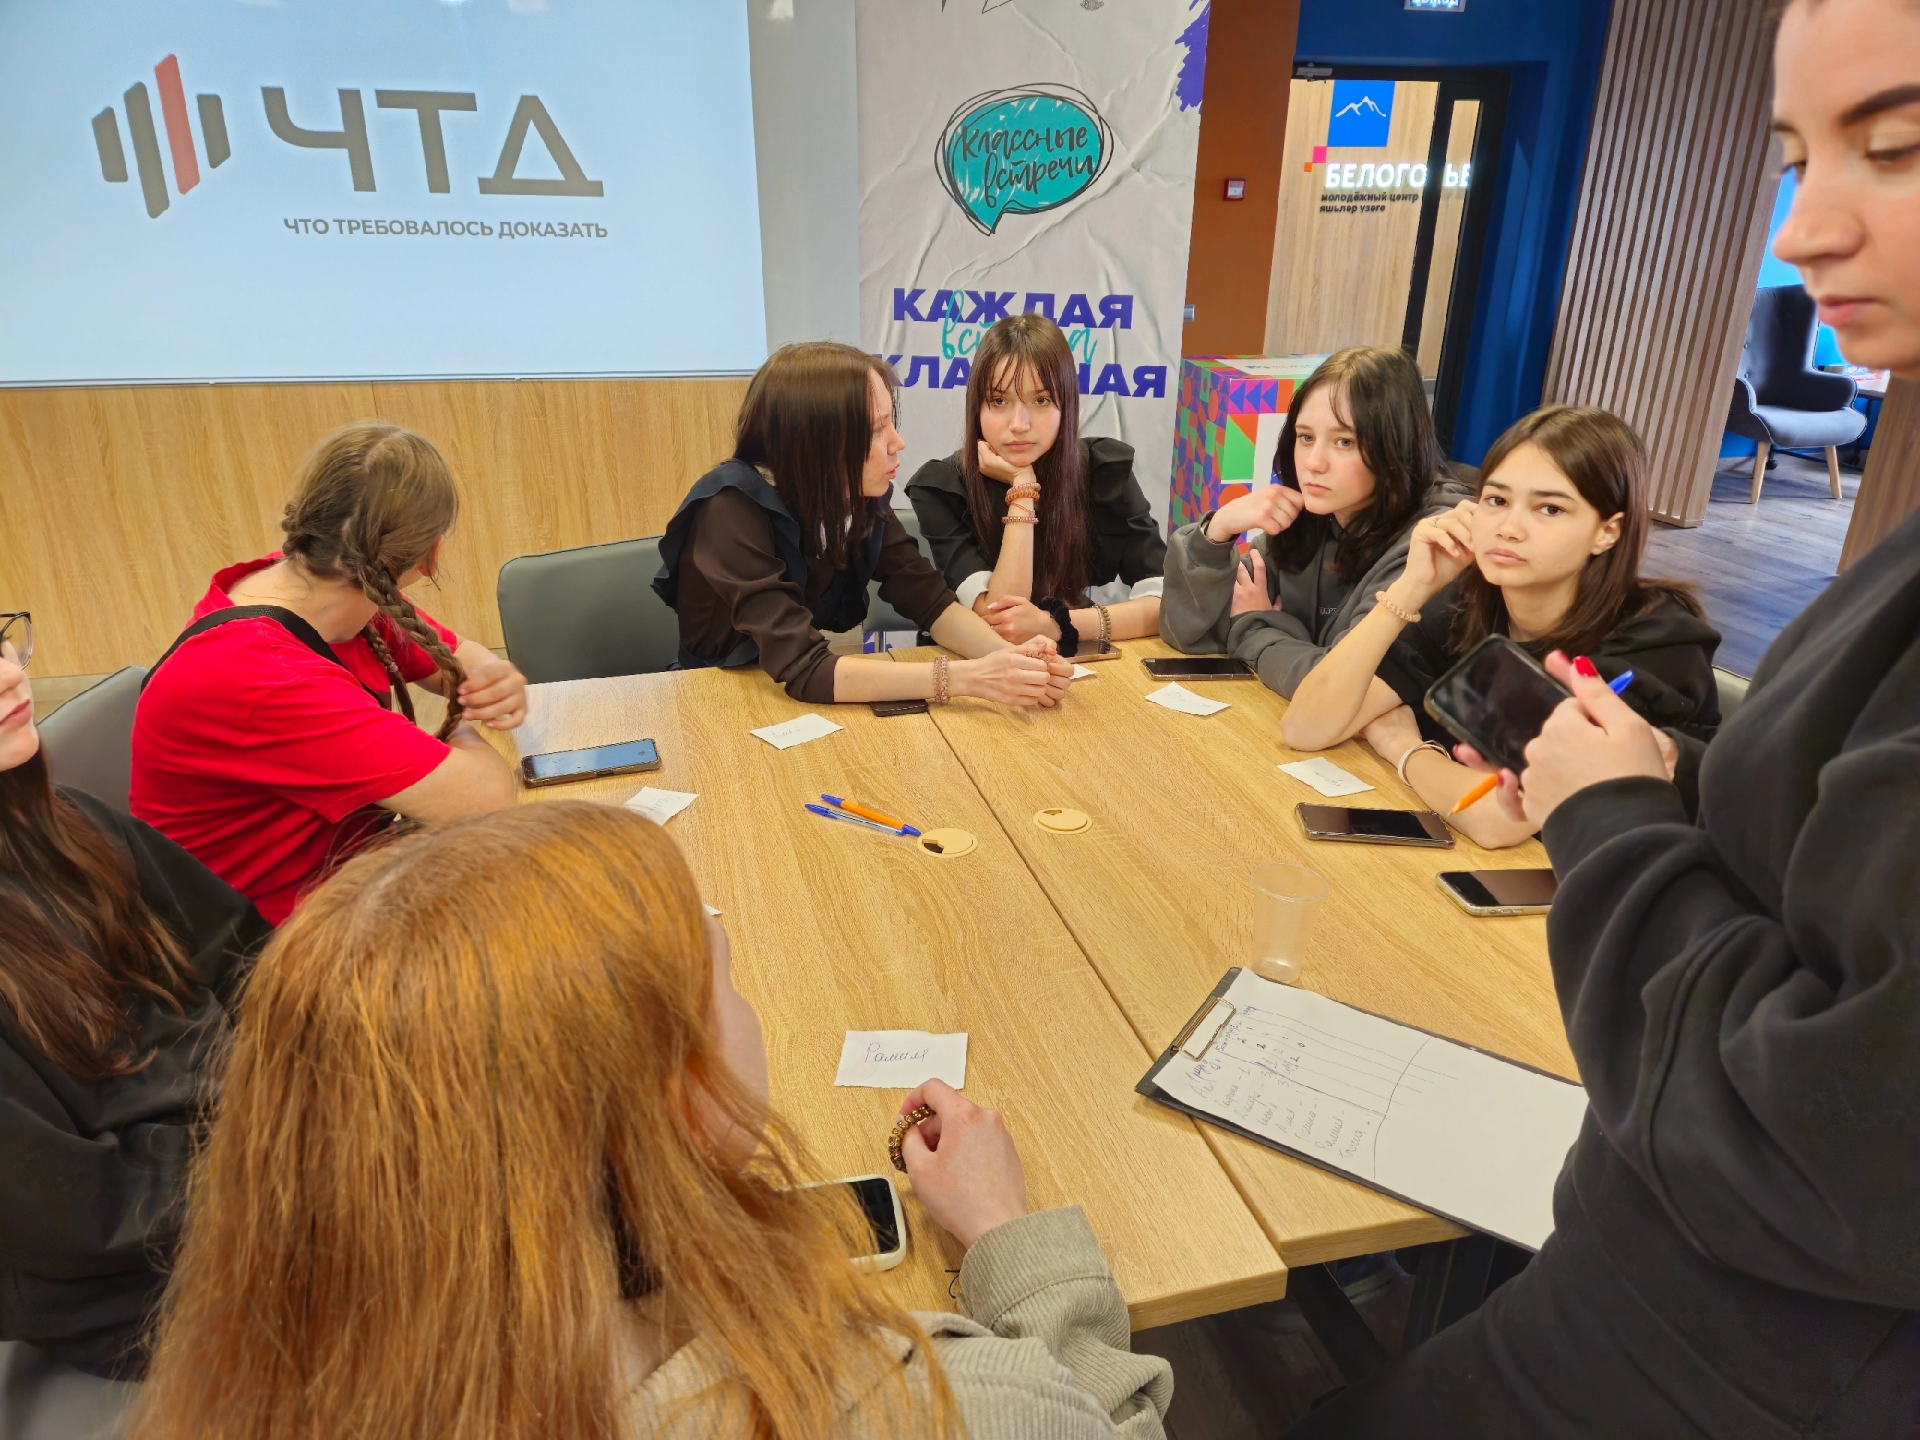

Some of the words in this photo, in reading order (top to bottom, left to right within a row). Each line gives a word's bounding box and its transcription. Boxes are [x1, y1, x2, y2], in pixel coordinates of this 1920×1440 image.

[260, 86, 605, 197] ЧТД
[961, 125, 1089, 163] Классные
[983, 151, 1095, 209] встречи
[1325, 162, 1471, 189] БЕЛОГОЬЕ
[1320, 191, 1387, 213] молодёжный
[1389, 193, 1419, 203] центр
[283, 218, 330, 236] ЧТО
[333, 218, 495, 238] ТРЕБОВАЛОСЬ
[498, 220, 608, 241] ДОКАЗАТЬ
[893, 288, 1134, 330] КАЖДАЯ
